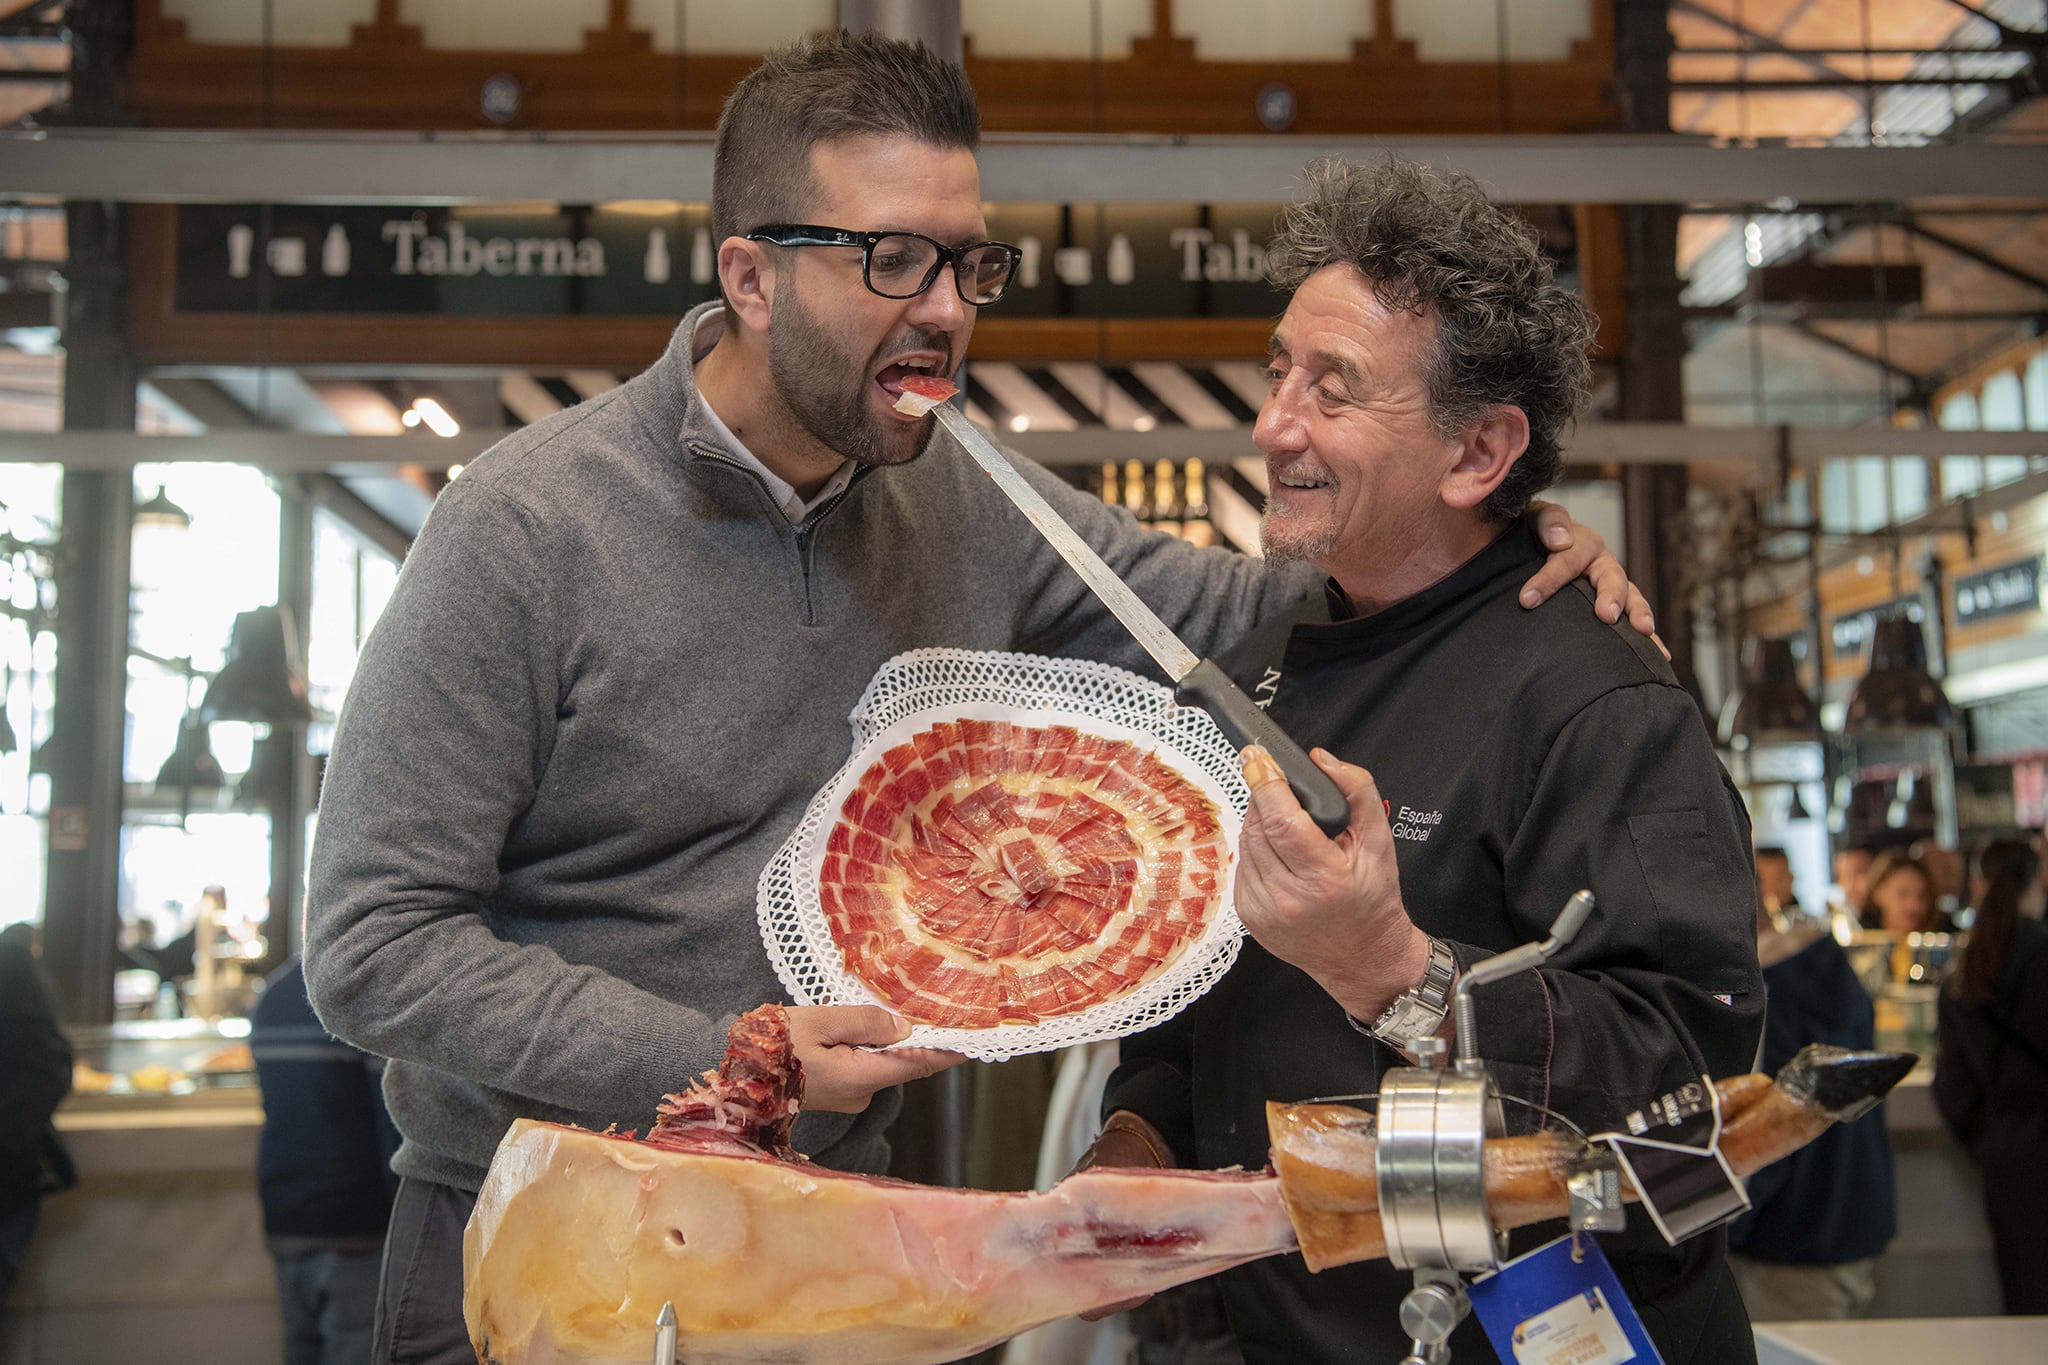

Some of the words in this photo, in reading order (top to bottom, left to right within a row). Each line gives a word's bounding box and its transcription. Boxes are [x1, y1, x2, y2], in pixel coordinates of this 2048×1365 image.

[382, 220, 607, 275] Taberna
[1398, 805, 1443, 826] España
[1392, 822, 1432, 841] Global
